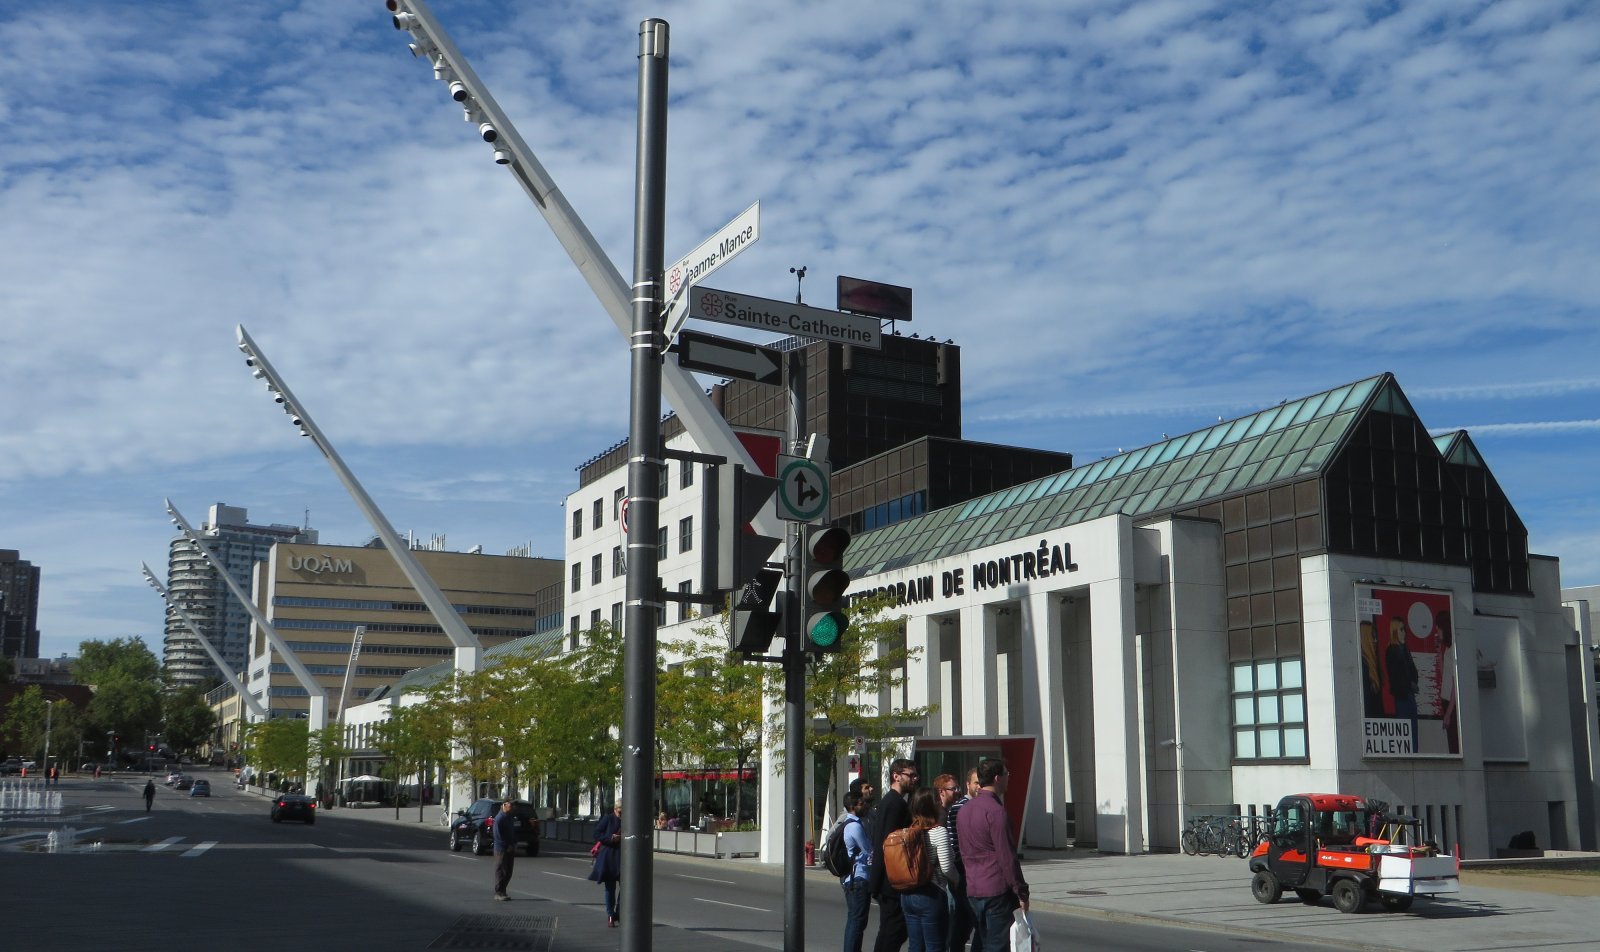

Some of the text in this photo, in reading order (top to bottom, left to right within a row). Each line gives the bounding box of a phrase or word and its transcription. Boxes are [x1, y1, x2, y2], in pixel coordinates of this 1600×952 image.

[686, 225, 753, 282] eanne-Mance
[724, 294, 738, 302] Rue
[724, 302, 872, 343] Sainte-Catherine
[288, 553, 353, 574] UQÀM
[942, 567, 965, 599] DE
[973, 538, 1079, 592] MONTRÉAL
[1364, 721, 1410, 737] EDMUND
[1365, 739, 1411, 754] ALLEYN
